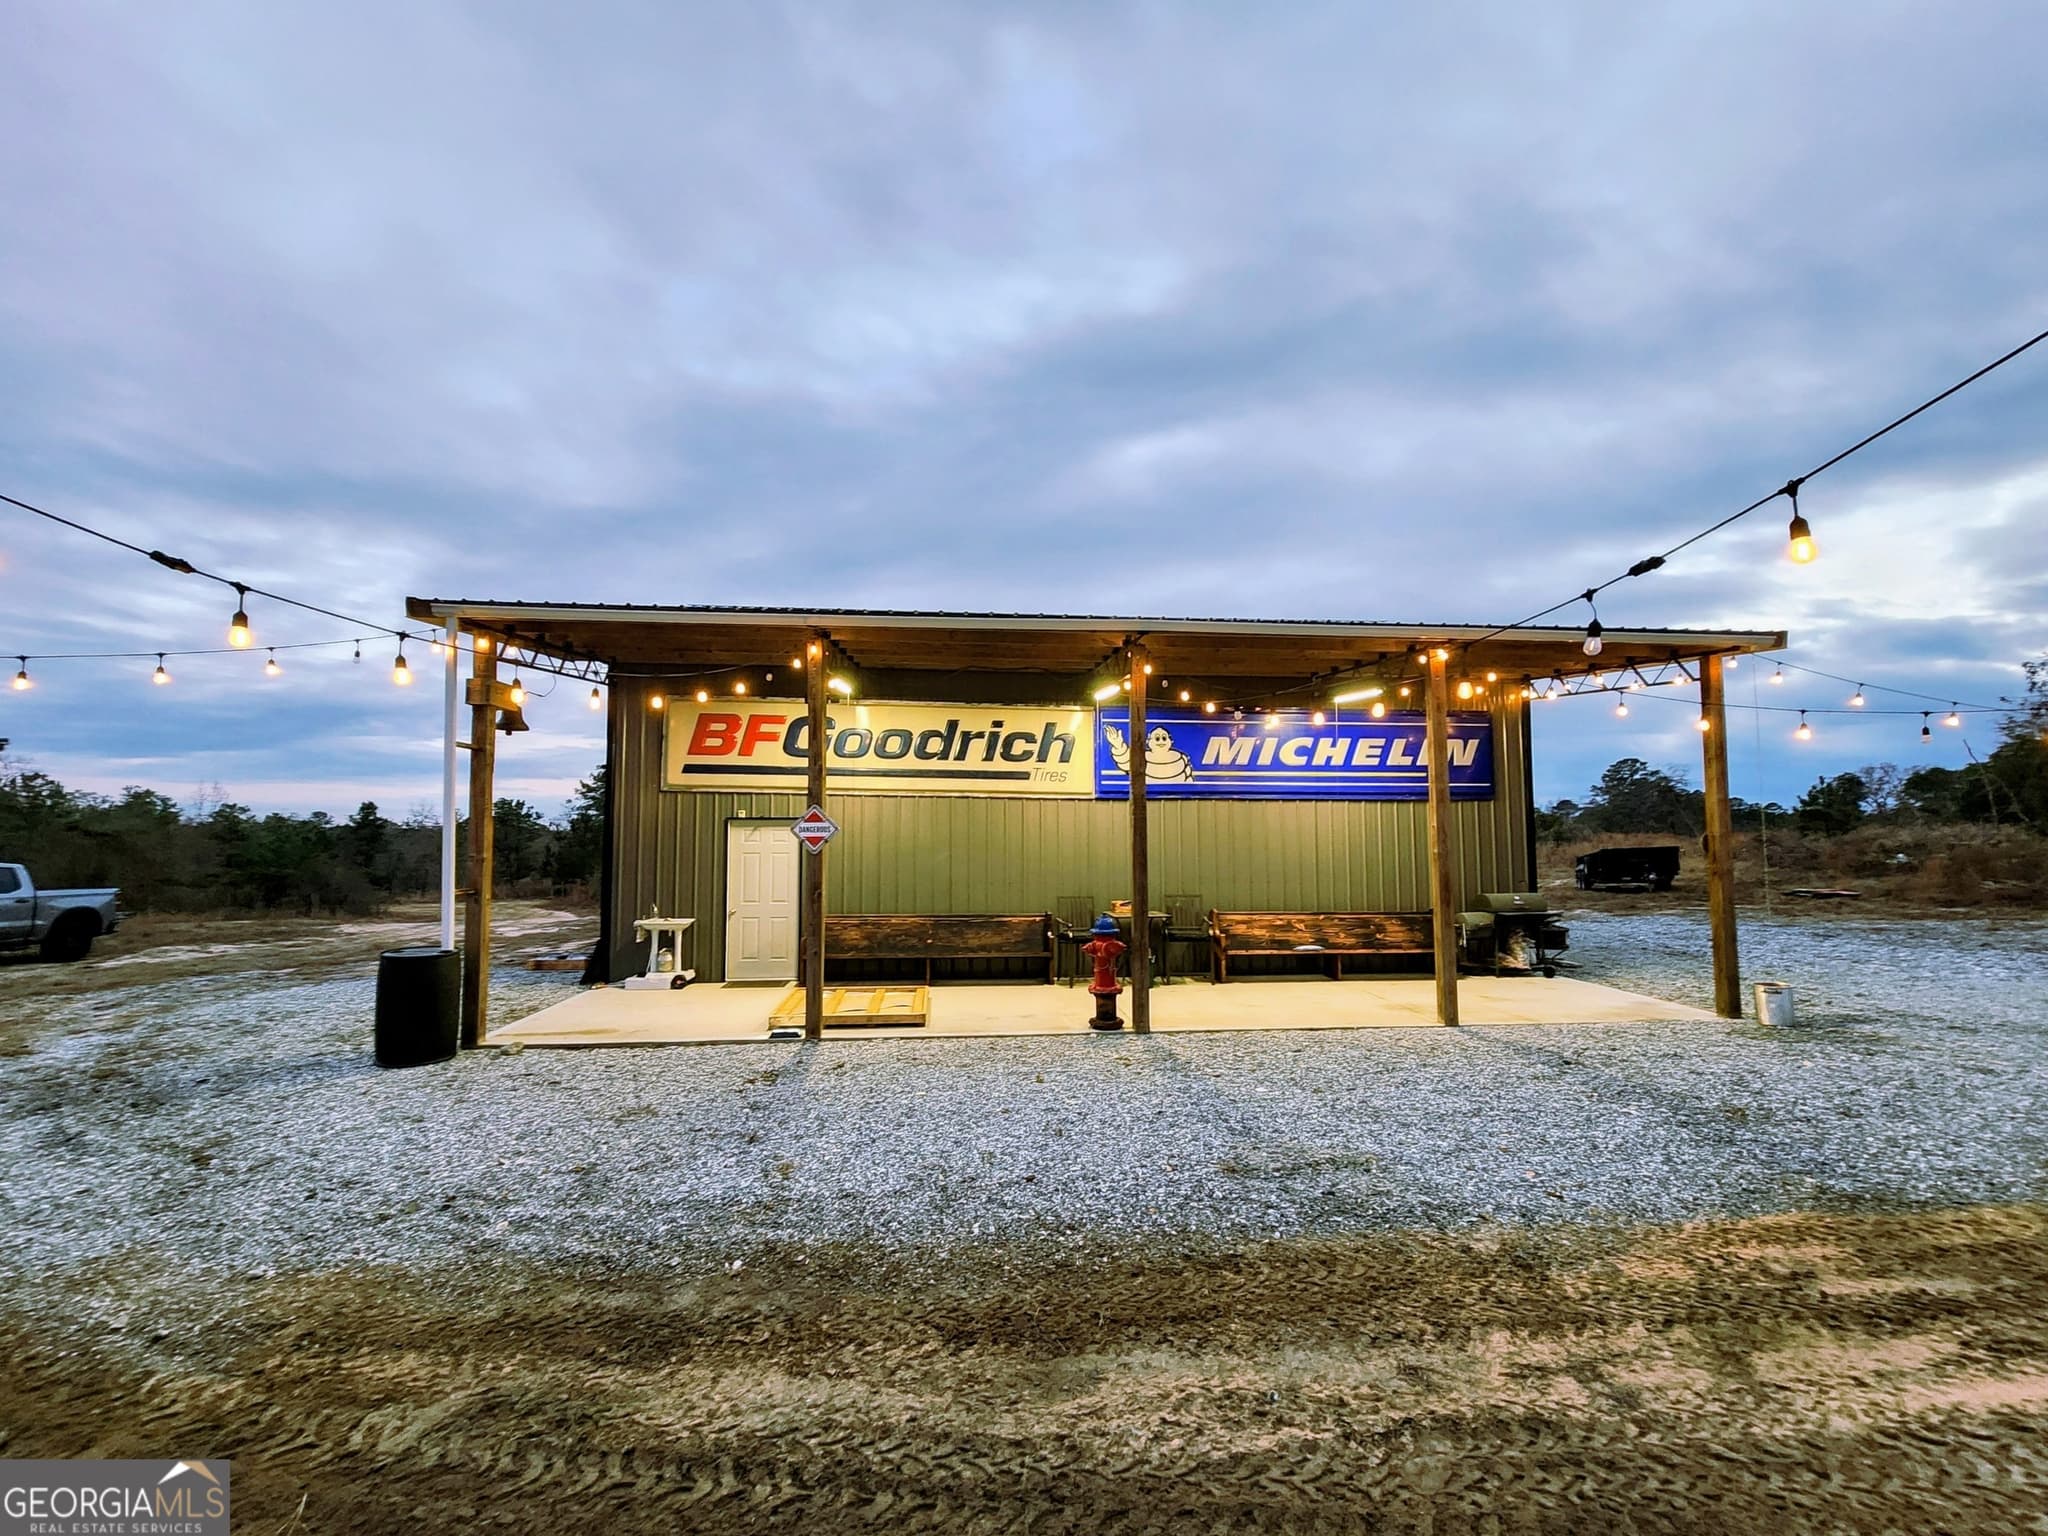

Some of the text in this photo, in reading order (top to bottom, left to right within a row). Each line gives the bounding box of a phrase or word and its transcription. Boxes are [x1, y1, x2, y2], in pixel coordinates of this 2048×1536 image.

[687, 713, 1076, 763] BFGoodrich
[1032, 767, 1068, 783] Tires
[799, 825, 831, 833] DANGEROUS
